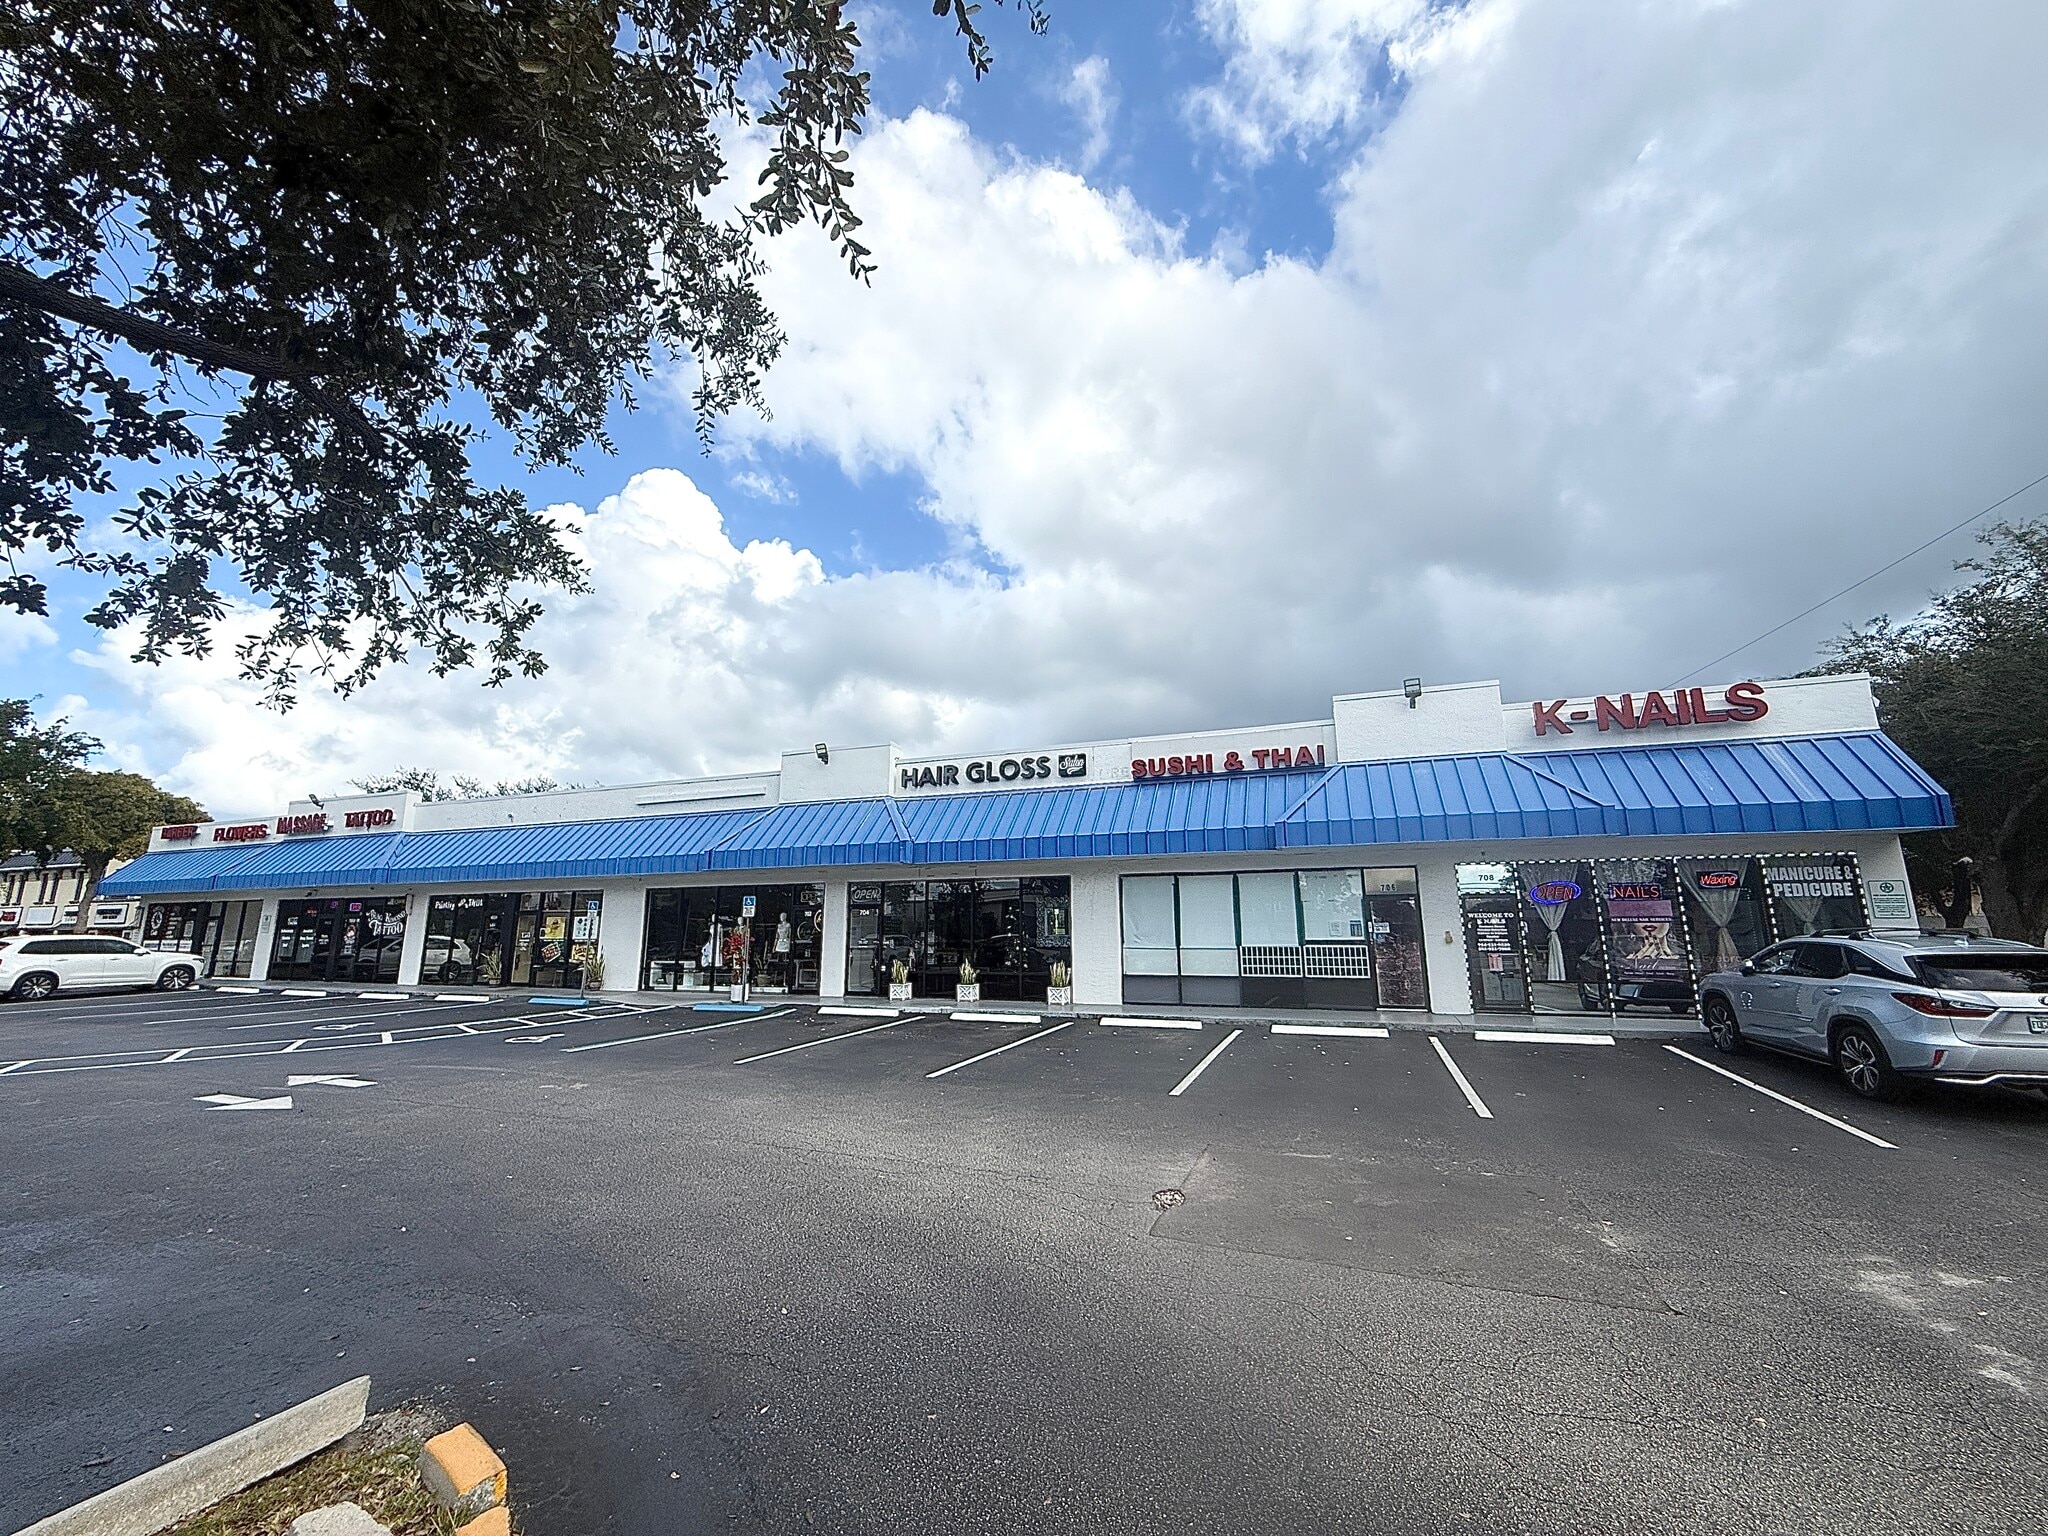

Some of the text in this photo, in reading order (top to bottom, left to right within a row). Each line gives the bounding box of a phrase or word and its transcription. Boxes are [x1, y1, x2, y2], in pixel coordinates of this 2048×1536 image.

[1532, 682, 1769, 736] K-NAILS
[1059, 755, 1085, 773] Salon
[1131, 753, 1214, 779] SUSHI
[1223, 751, 1245, 770] &
[1252, 744, 1326, 769] THAI
[901, 756, 1051, 789] HAIR GLOSS
[276, 813, 327, 835] MASSAGE
[344, 809, 394, 828] TATTOO
[213, 824, 268, 842] FLOWERS
[1700, 873, 1737, 887] Waxing
[1767, 865, 1853, 881] MANICURE &
[854, 888, 879, 899] OPEN
[1380, 884, 1396, 892] 706
[1538, 885, 1573, 901] OPEN
[1613, 886, 1660, 898] NAILS
[1773, 882, 1853, 898] PEDICURE
[368, 919, 403, 937] TATTOO
